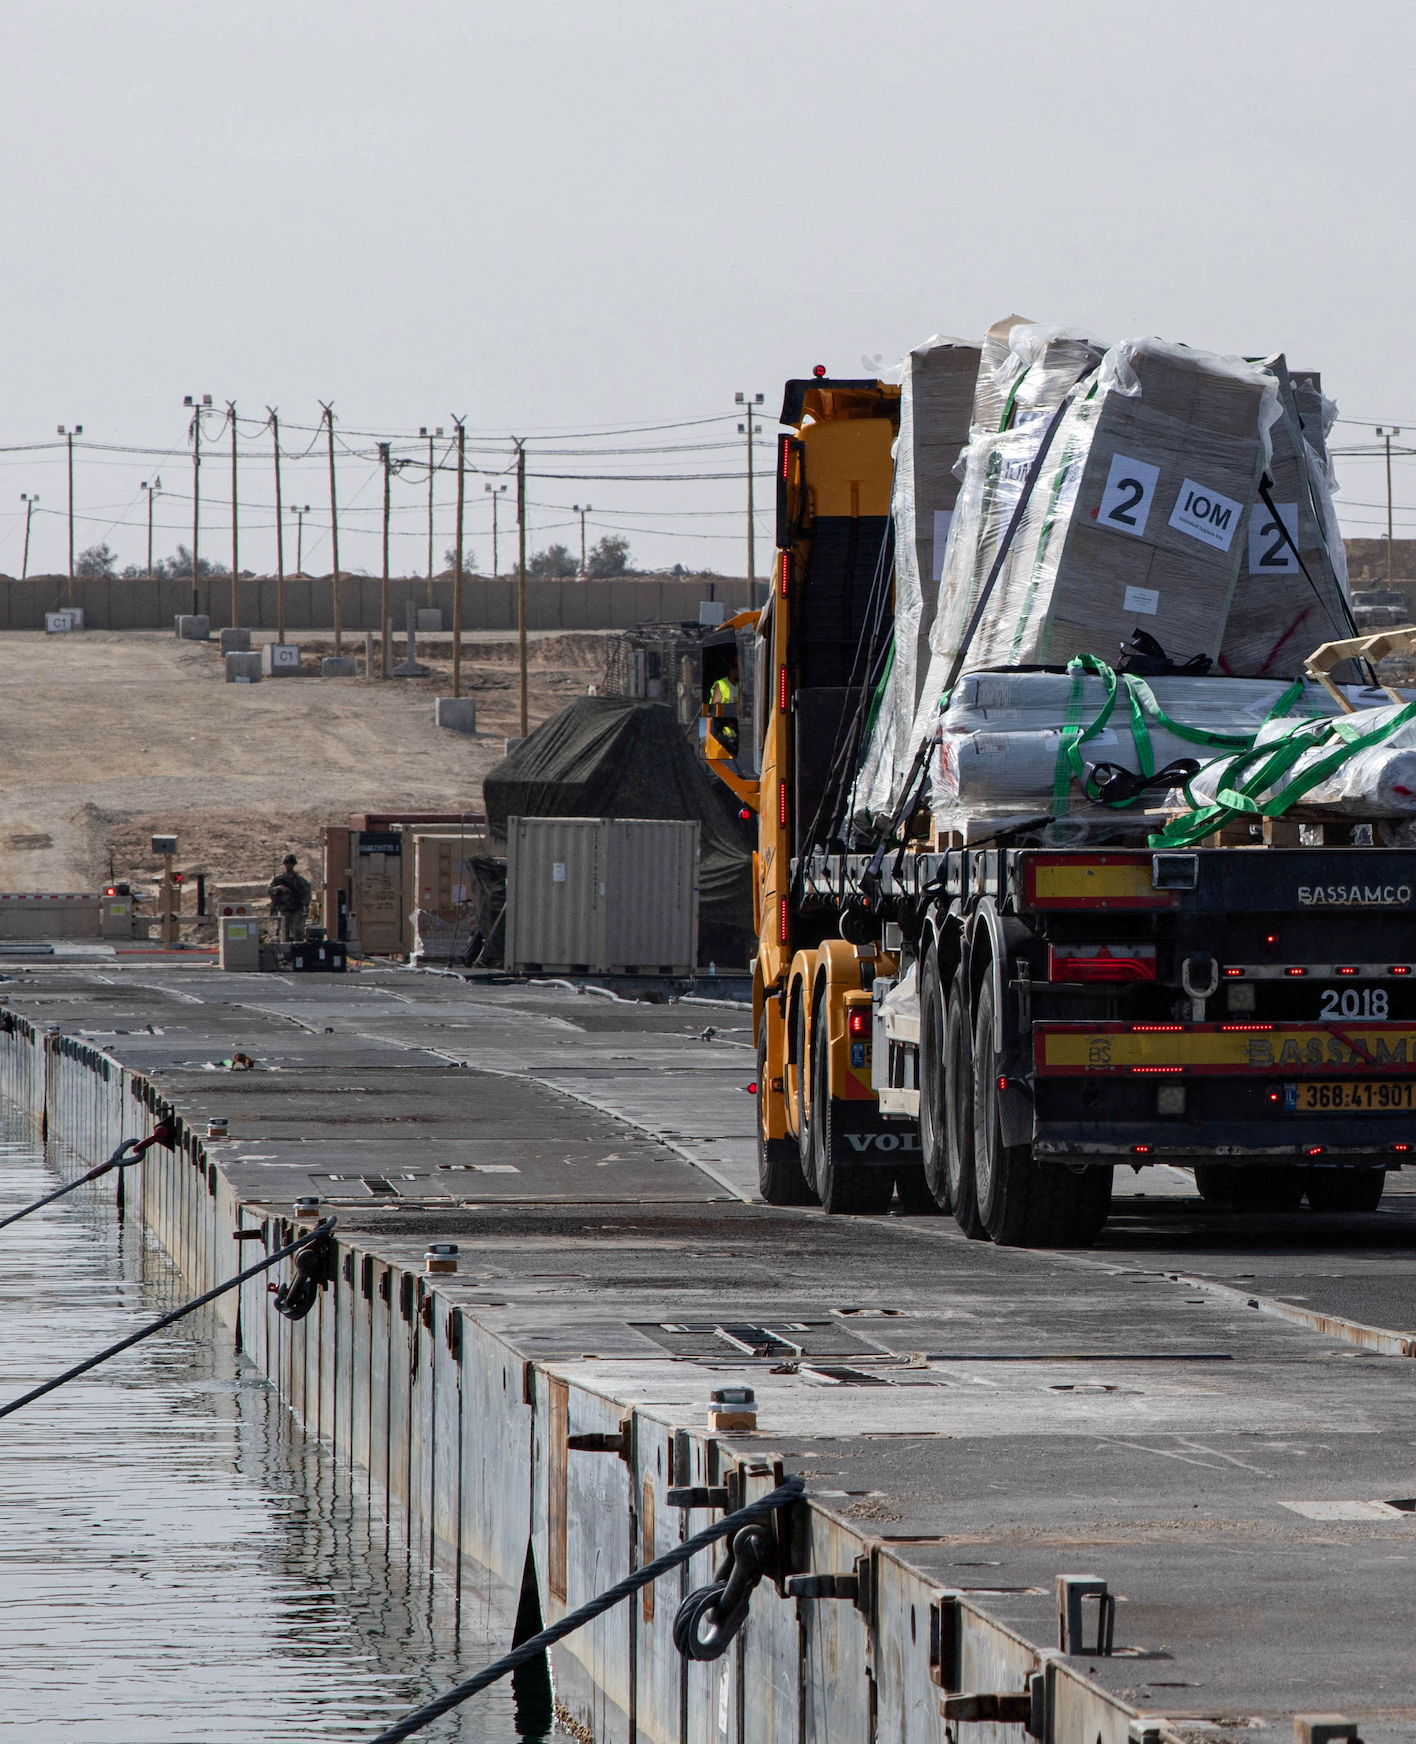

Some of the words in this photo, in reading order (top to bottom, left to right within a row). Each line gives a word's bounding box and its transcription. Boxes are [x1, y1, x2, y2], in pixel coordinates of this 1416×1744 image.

[1108, 478, 1144, 527] 2
[1184, 490, 1232, 531] IOM
[1259, 521, 1289, 566] 2
[53, 618, 66, 628] C1
[280, 650, 293, 662] C1
[1297, 884, 1412, 905] BASSAMCO
[1320, 988, 1389, 1022] 2018
[1089, 1047, 1111, 1063] BS
[1286, 1092, 1294, 1102] IL
[843, 1133, 922, 1152] VOL
